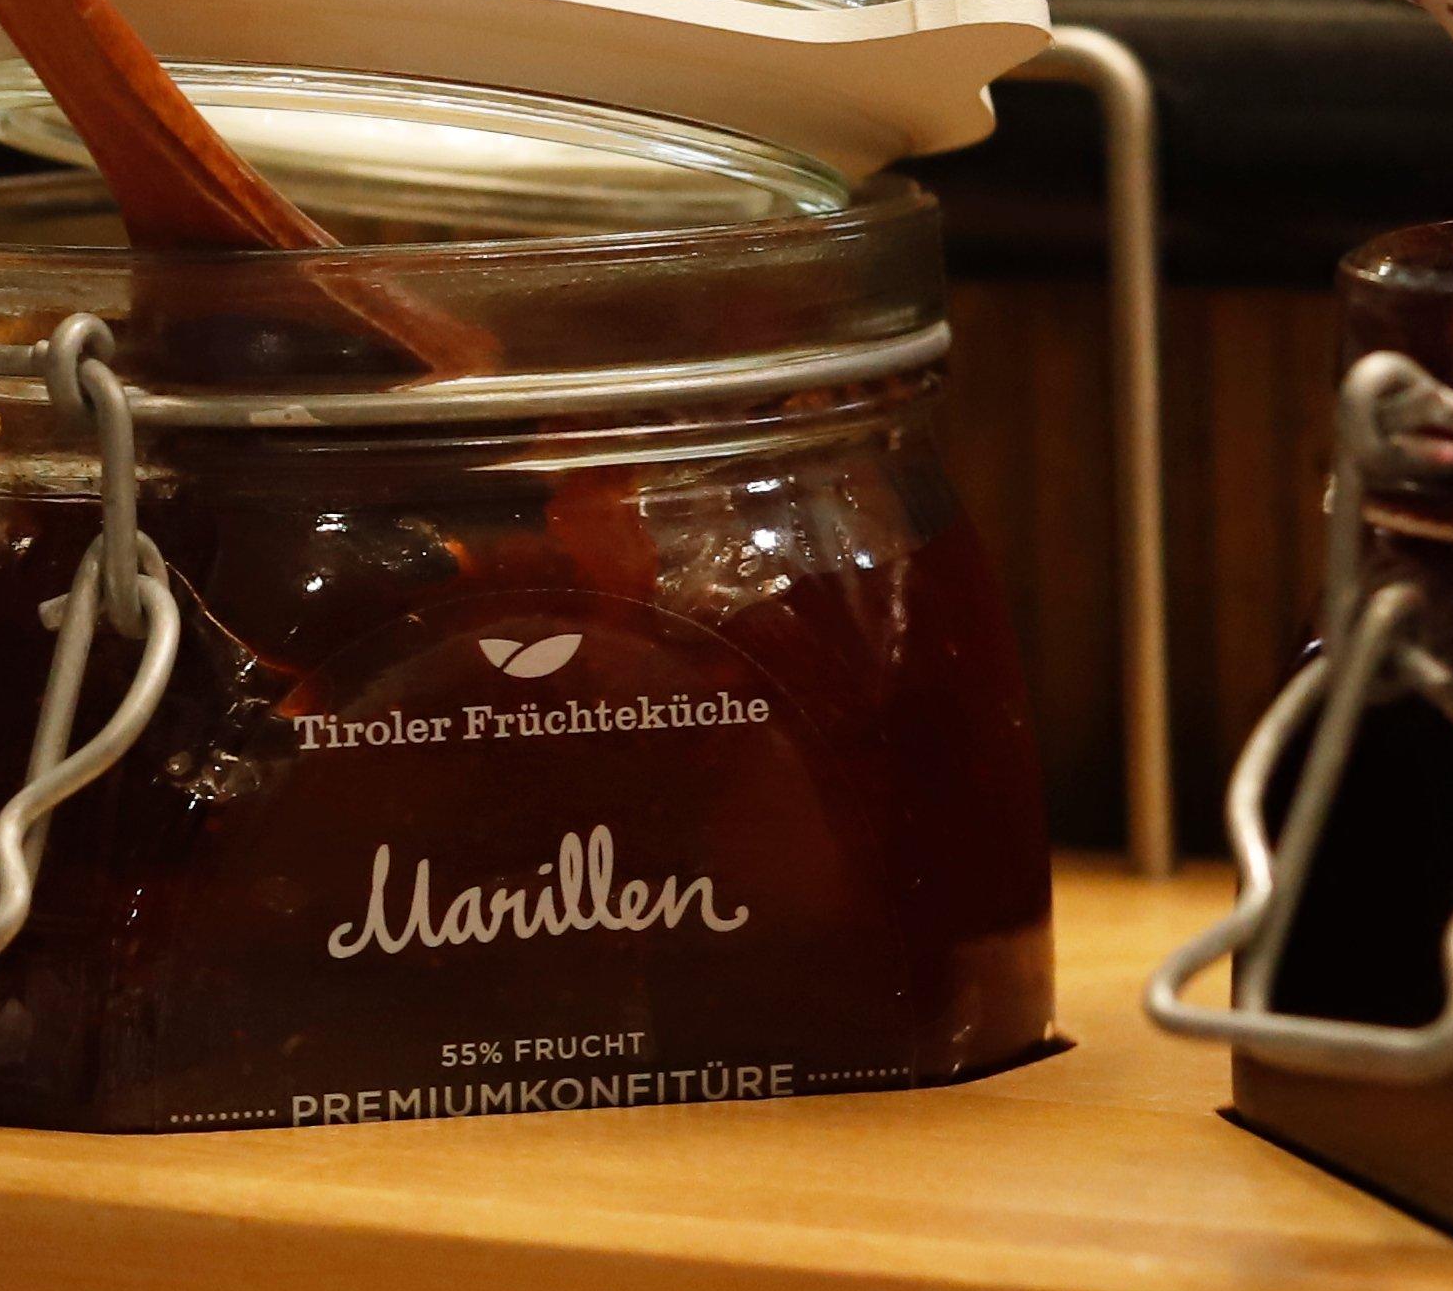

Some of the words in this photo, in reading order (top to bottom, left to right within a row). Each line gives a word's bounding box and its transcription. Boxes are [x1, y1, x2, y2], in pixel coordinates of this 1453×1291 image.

[293, 710, 452, 751] Tiroler
[462, 691, 770, 741] Früchteküche
[327, 824, 750, 959] Marillen
[441, 1041, 504, 1068] 55%
[514, 1031, 647, 1063] FRUCHT
[292, 1061, 794, 1127] PREMIUMKONFITÜRE
